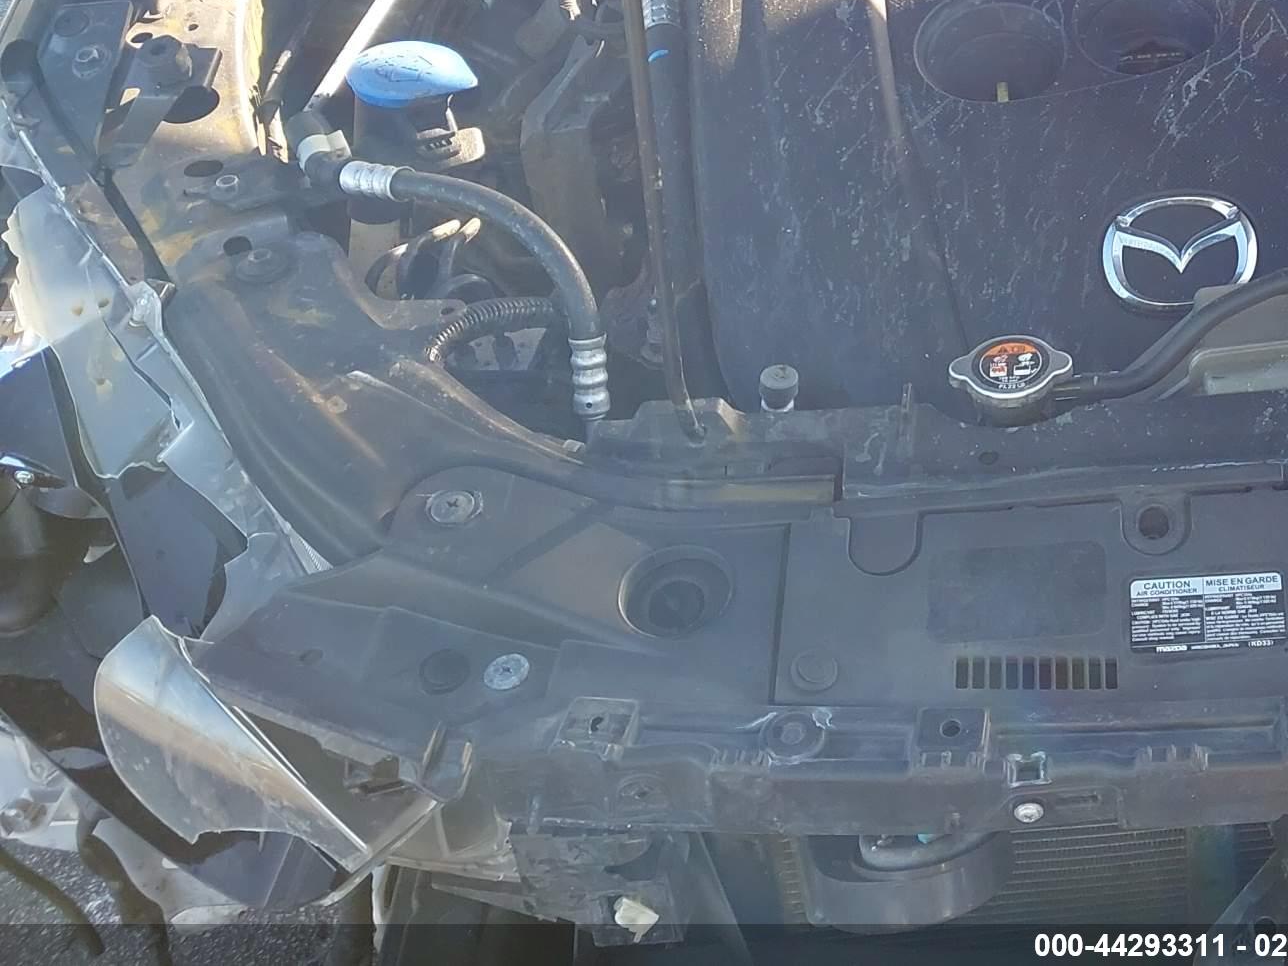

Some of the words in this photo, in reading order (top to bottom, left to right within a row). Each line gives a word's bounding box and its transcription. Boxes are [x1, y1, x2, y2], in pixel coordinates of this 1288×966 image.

[1143, 580, 1191, 590] CAUTION
[1205, 579, 1228, 587] MISE
[1230, 577, 1244, 585] EN
[1244, 575, 1279, 585] GARDE
[1149, 587, 1198, 596] CONDITIONER
[1218, 584, 1265, 592] CLIMATISEUR
[1156, 645, 1188, 653] mazda
